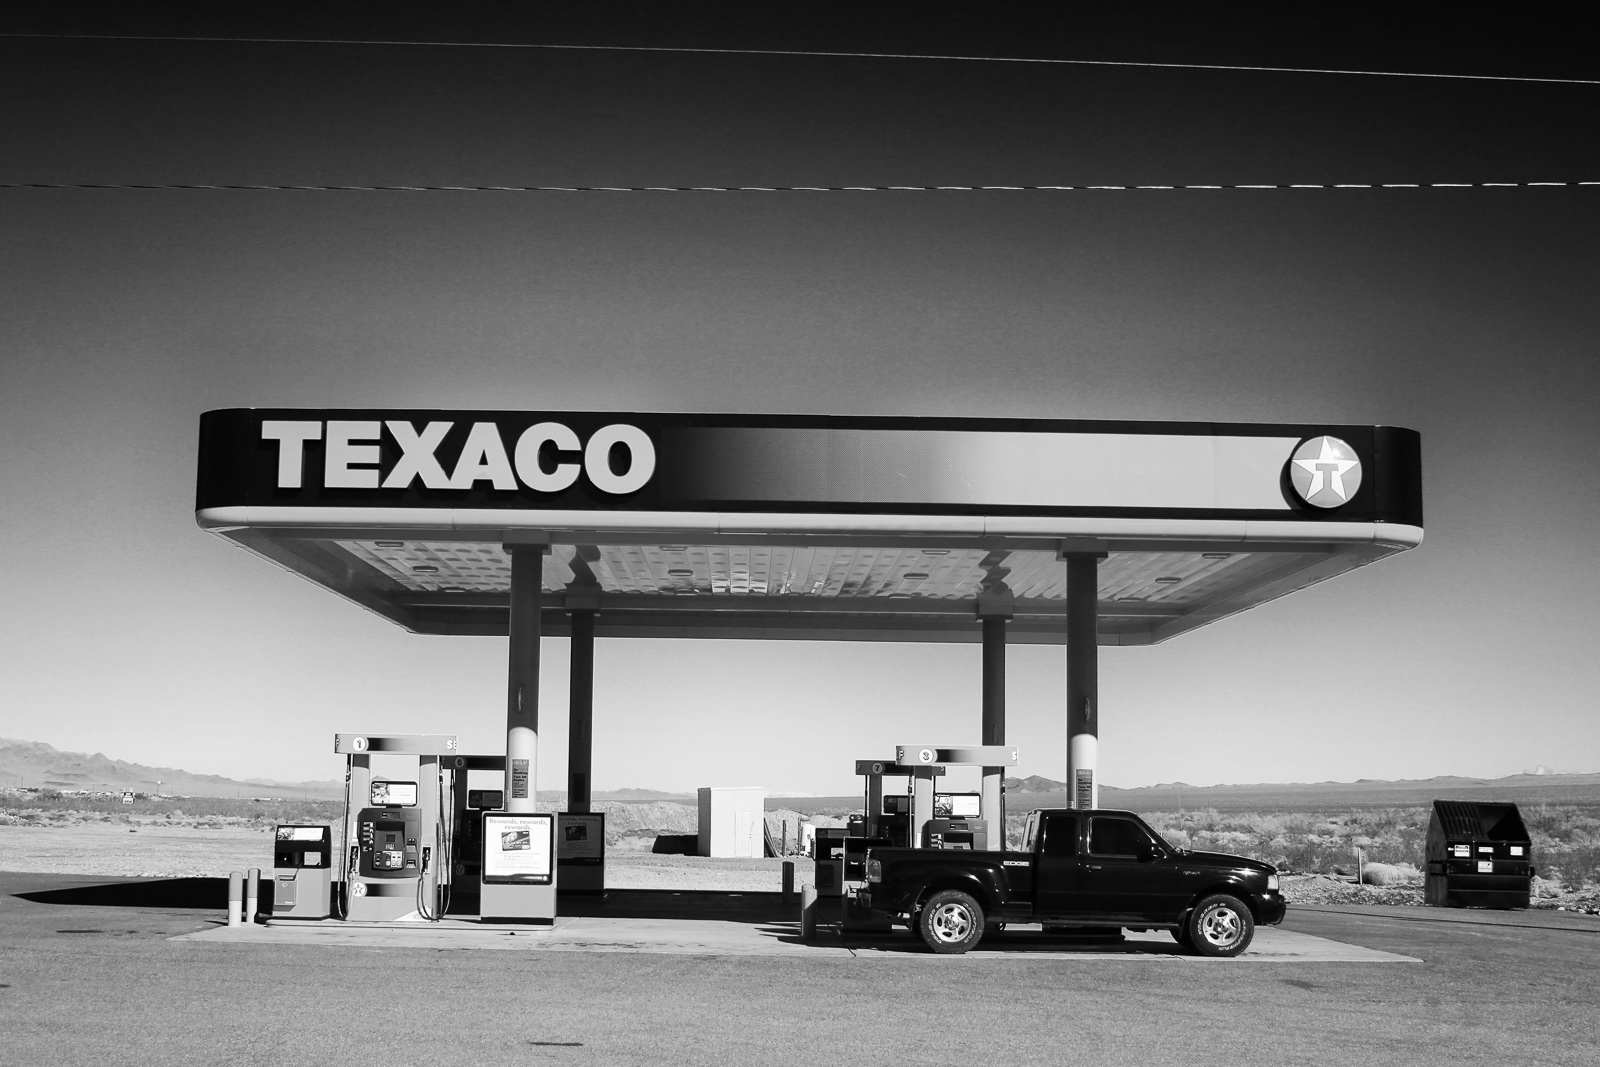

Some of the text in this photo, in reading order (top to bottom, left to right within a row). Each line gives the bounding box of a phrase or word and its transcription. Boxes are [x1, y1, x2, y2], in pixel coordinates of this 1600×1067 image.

[261, 420, 656, 495] TEXACO
[1316, 463, 1339, 489] T
[923, 751, 930, 761] 3
[1011, 751, 1018, 761] S
